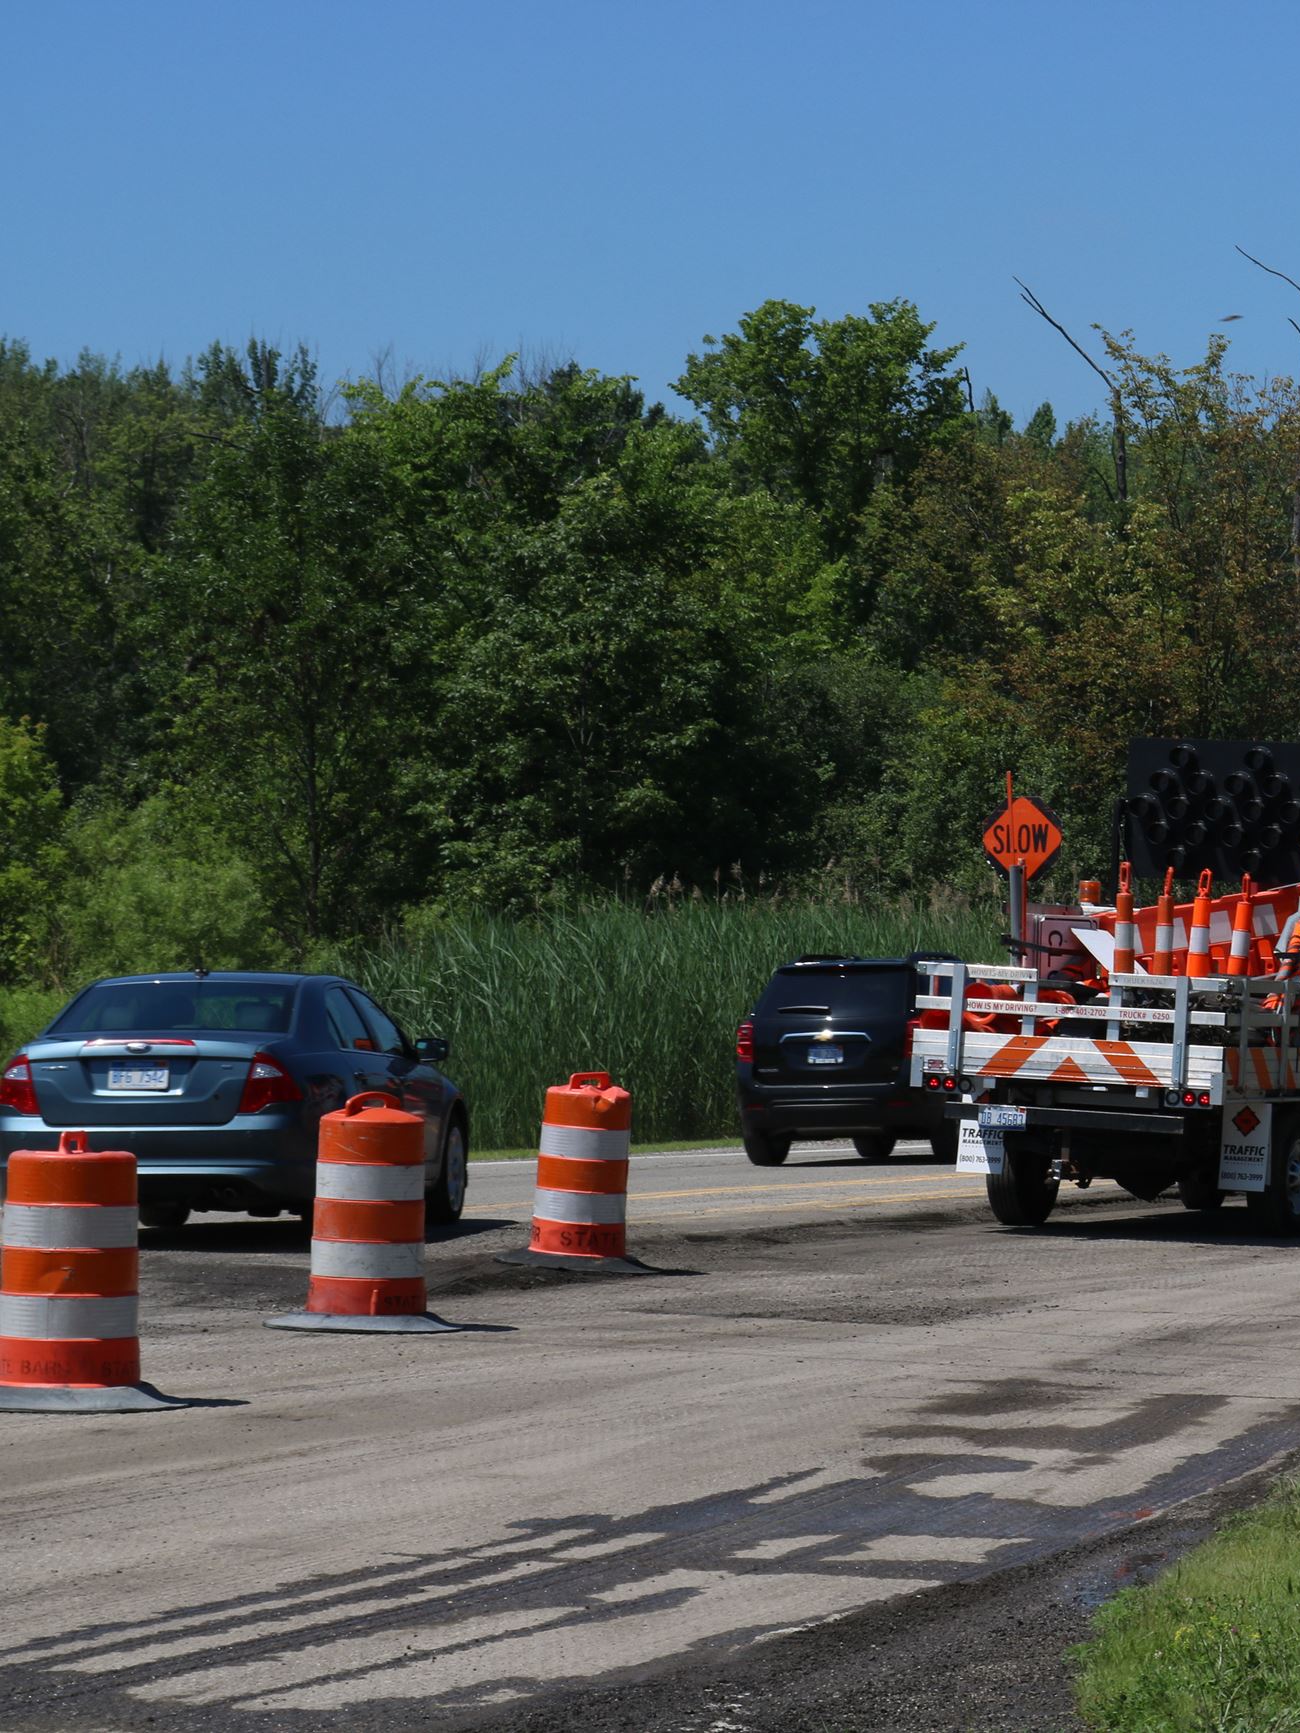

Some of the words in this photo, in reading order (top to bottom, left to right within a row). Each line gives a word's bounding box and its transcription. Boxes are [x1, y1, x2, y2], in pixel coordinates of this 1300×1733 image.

[993, 824, 1049, 854] SLOW
[966, 1002, 983, 1010] HOW
[984, 1002, 992, 1010] IS
[992, 1003, 1005, 1011] MY
[1005, 1004, 1037, 1013] DRIVING?
[1152, 1012, 1170, 1021] 6250
[138, 1071, 164, 1084] 7542
[962, 1128, 1004, 1139] TRAFFIC
[962, 1138, 1004, 1146] MANAGEMENT
[1224, 1145, 1265, 1157] TRAFFIC
